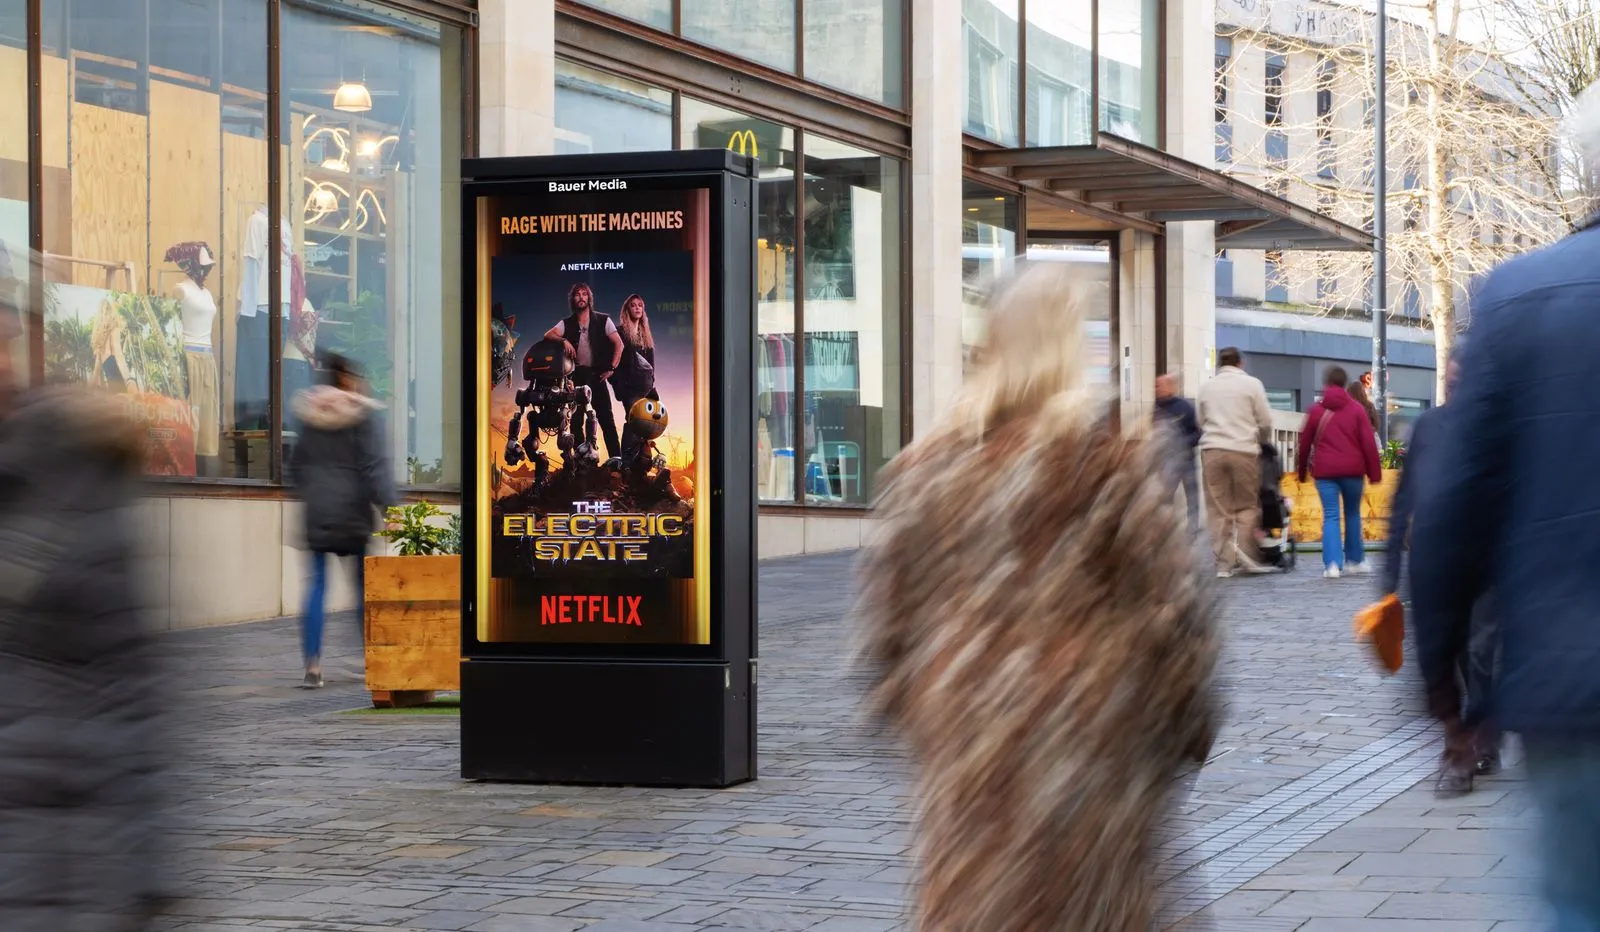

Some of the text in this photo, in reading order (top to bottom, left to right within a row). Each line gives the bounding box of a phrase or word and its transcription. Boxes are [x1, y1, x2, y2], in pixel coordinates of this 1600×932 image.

[548, 178, 627, 193] Bauer Media
[501, 210, 683, 234] RAGE WITH THE MACHINES
[560, 261, 624, 271] A NETFLIX FILM
[573, 501, 612, 514] THE
[503, 513, 683, 537] ELECTRIC
[535, 535, 650, 561] STATE
[541, 595, 643, 627] NETFLIX
